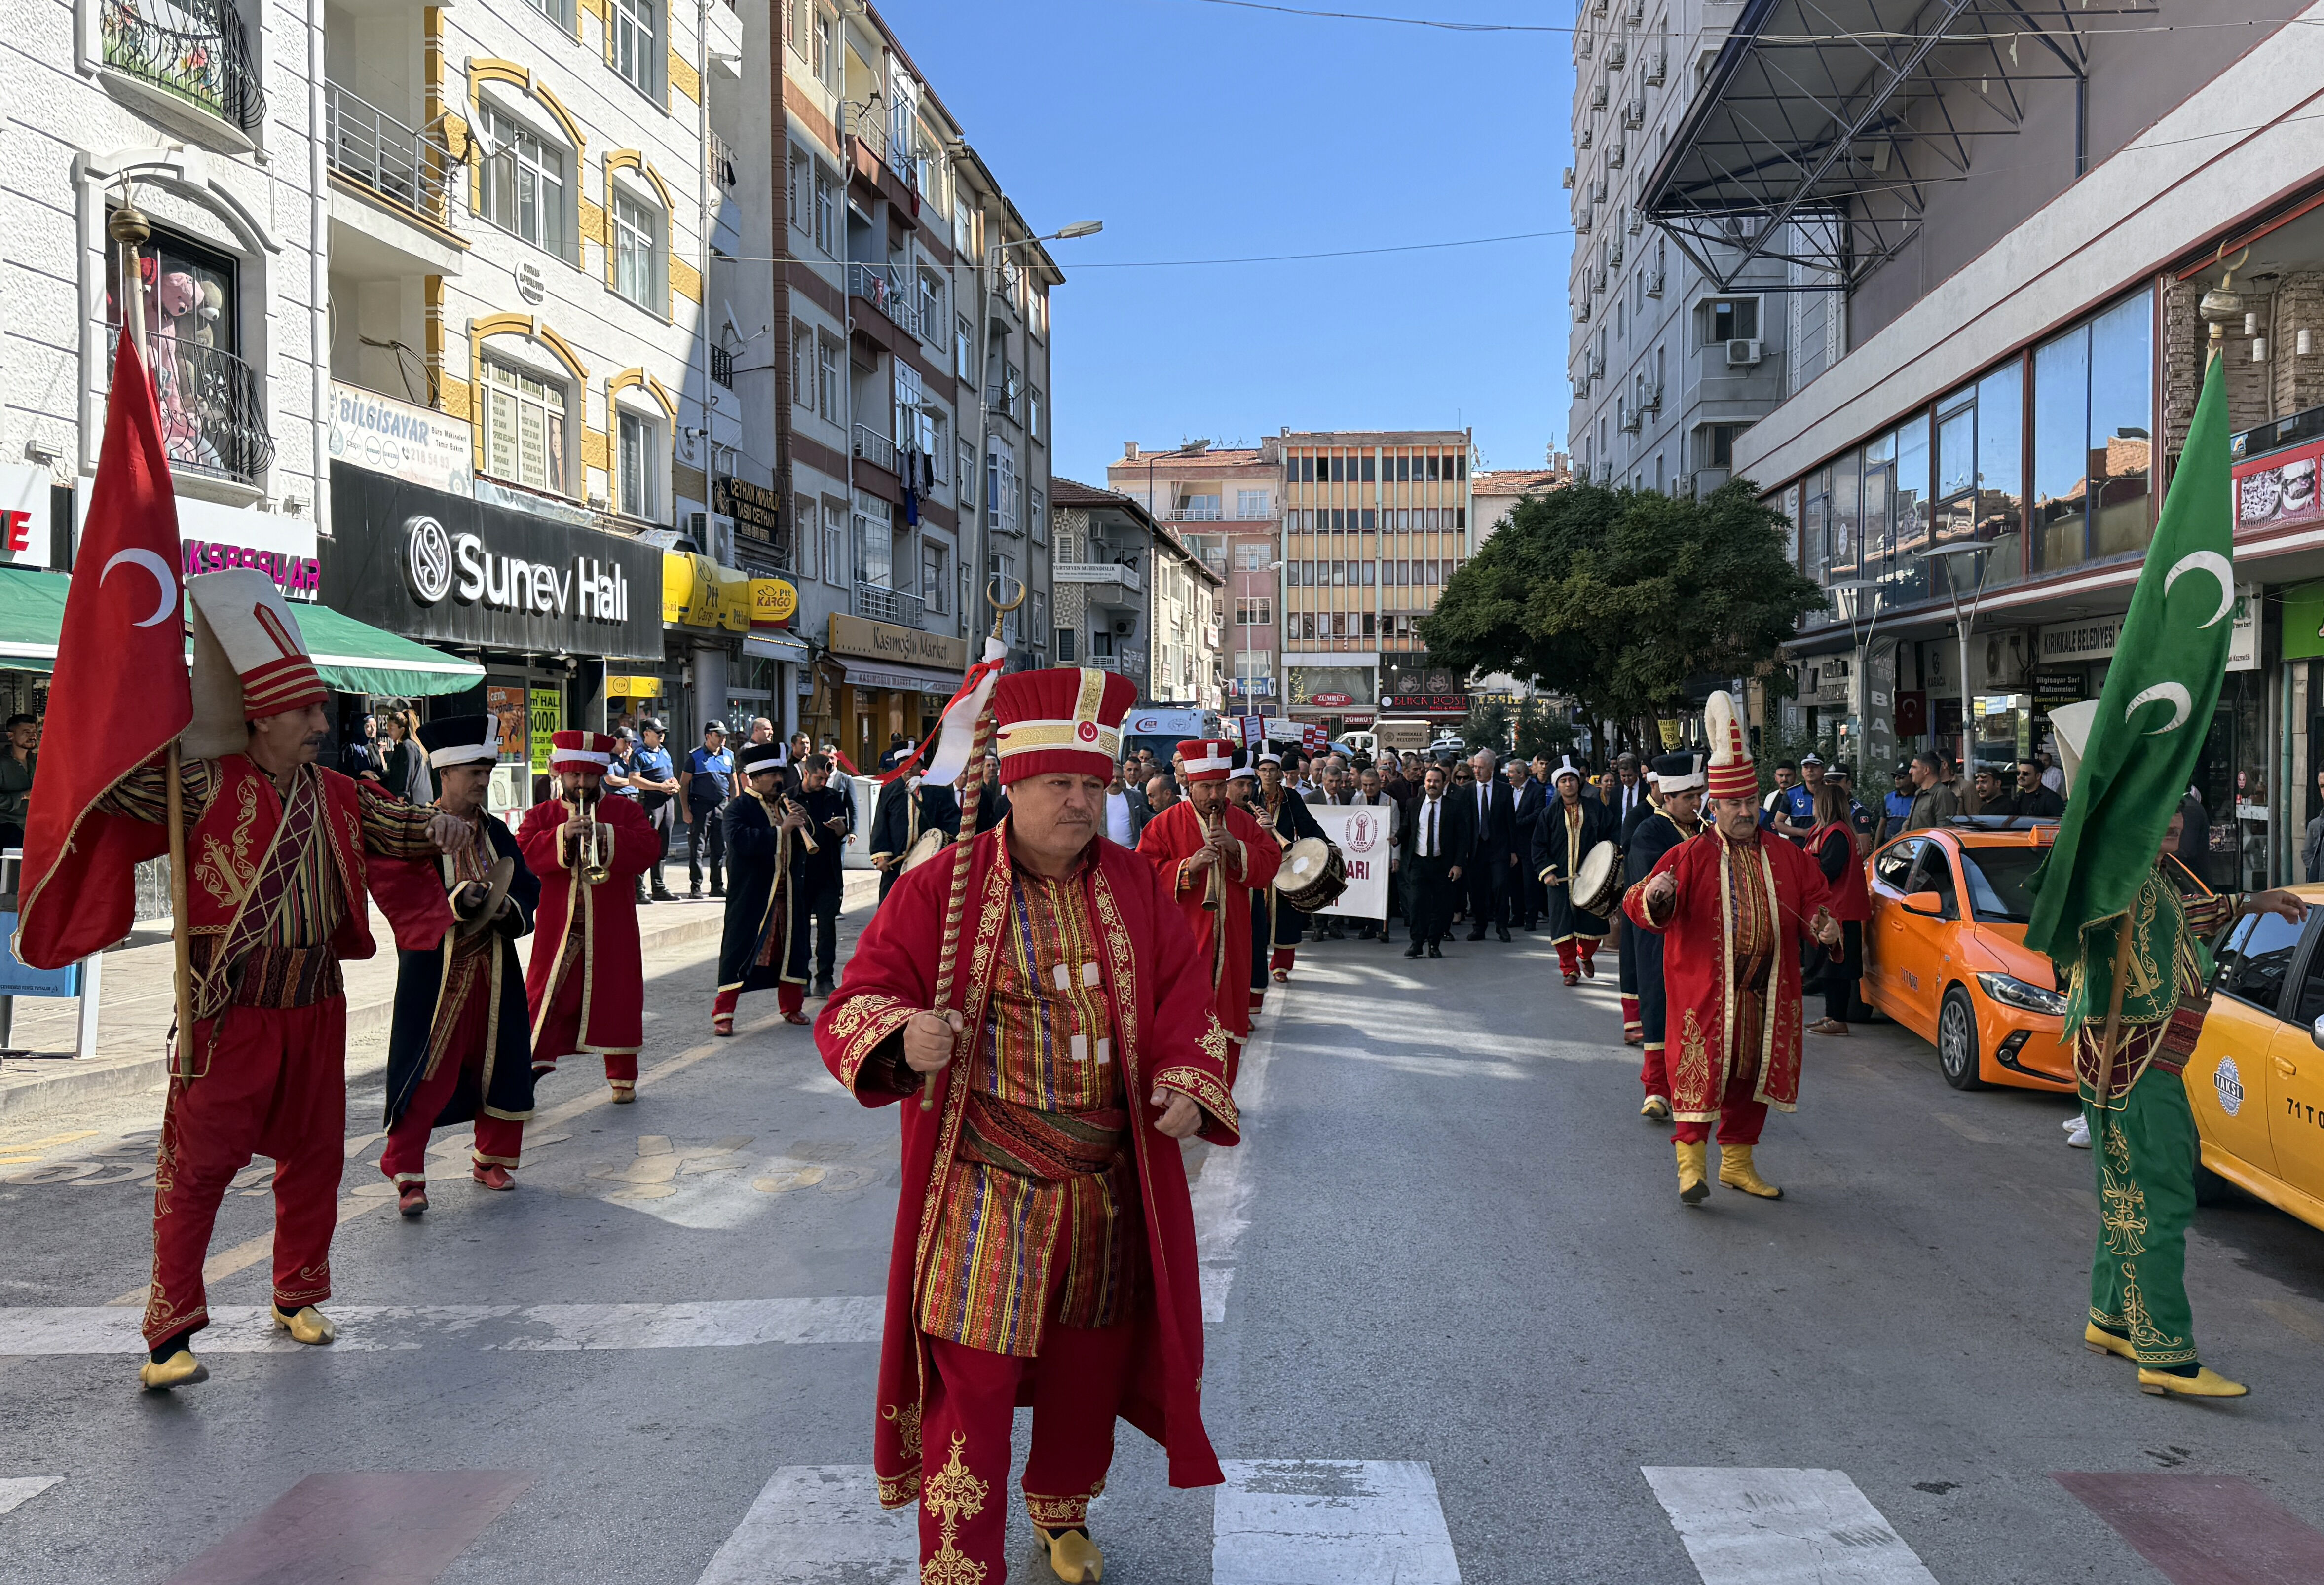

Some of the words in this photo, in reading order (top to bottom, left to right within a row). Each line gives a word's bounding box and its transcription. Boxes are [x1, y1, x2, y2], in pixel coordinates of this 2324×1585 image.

[340, 393, 429, 447] BİLGİSAYAR
[181, 539, 320, 590] KSESSUAR
[458, 534, 572, 614] Sunev
[578, 556, 628, 622] Halı
[706, 584, 719, 608] Ptt
[756, 596, 791, 607] KARGO
[873, 626, 917, 659] Kasımoğlu
[920, 635, 947, 660] Market
[2044, 630, 2076, 655] KIRIKKALE
[2077, 620, 2115, 652] BELEDİYESİ
[1433, 696, 1466, 705] ROSE
[2216, 1074, 2240, 1098] TAKSİ
[2287, 1097, 2301, 1119] 71
[2305, 1105, 2314, 1124] T
